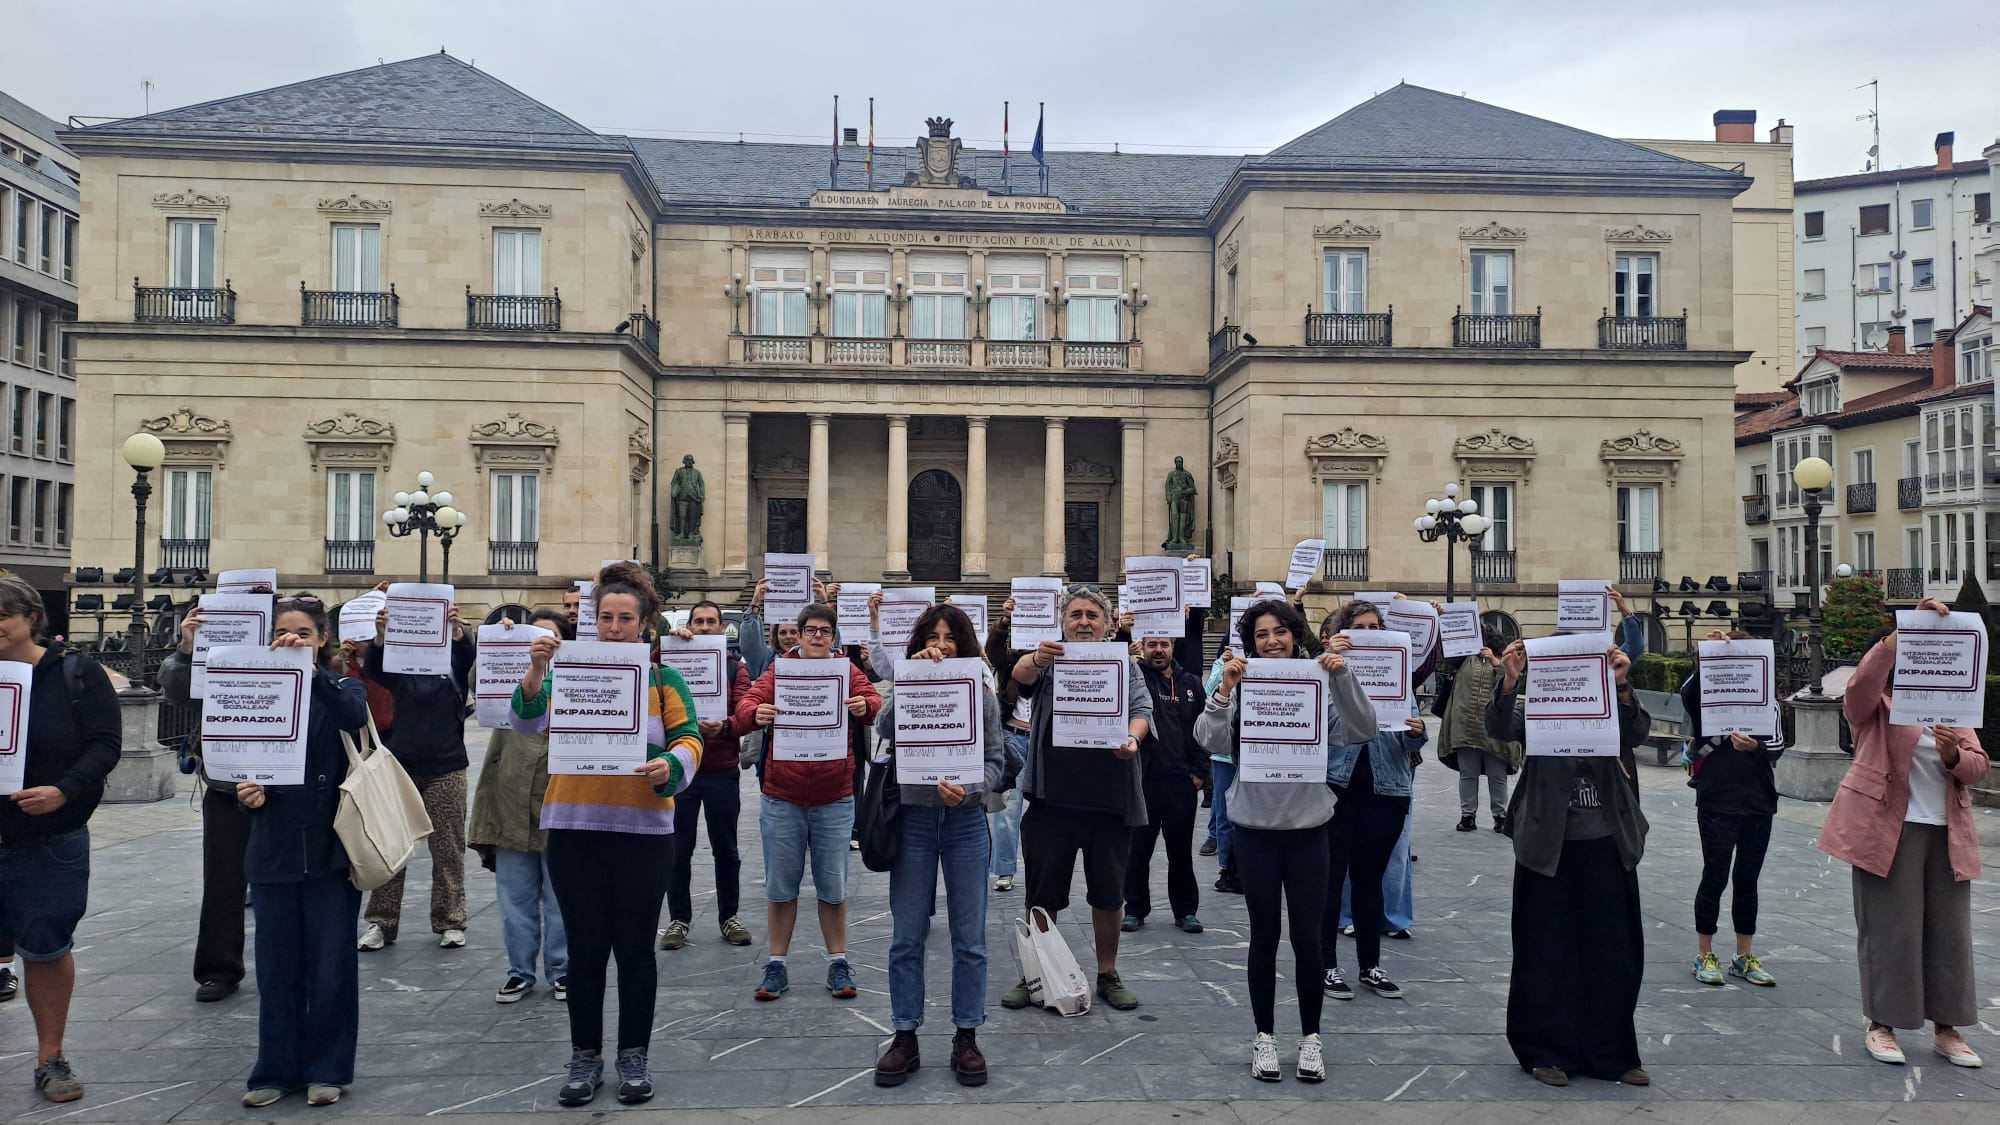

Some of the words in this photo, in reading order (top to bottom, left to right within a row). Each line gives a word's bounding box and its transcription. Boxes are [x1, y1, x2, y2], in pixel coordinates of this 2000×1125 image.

[814, 194, 879, 205] ALDUNDIAREN
[888, 197, 928, 206] JAUREGIA
[938, 199, 976, 208] PALACIO
[981, 200, 992, 208] DE
[998, 201, 1009, 209] LA
[1015, 202, 1061, 210] PROVINCIA
[747, 230, 804, 240] ARABAKO
[820, 231, 851, 241] FORU
[867, 232, 926, 243] ALDUNDIA
[1024, 236, 1061, 246] FORAL
[1070, 238, 1084, 247] DE
[898, 722, 965, 730] EKIPARAZIOA!
[1244, 720, 1310, 728] EKIPARAZIOA!
